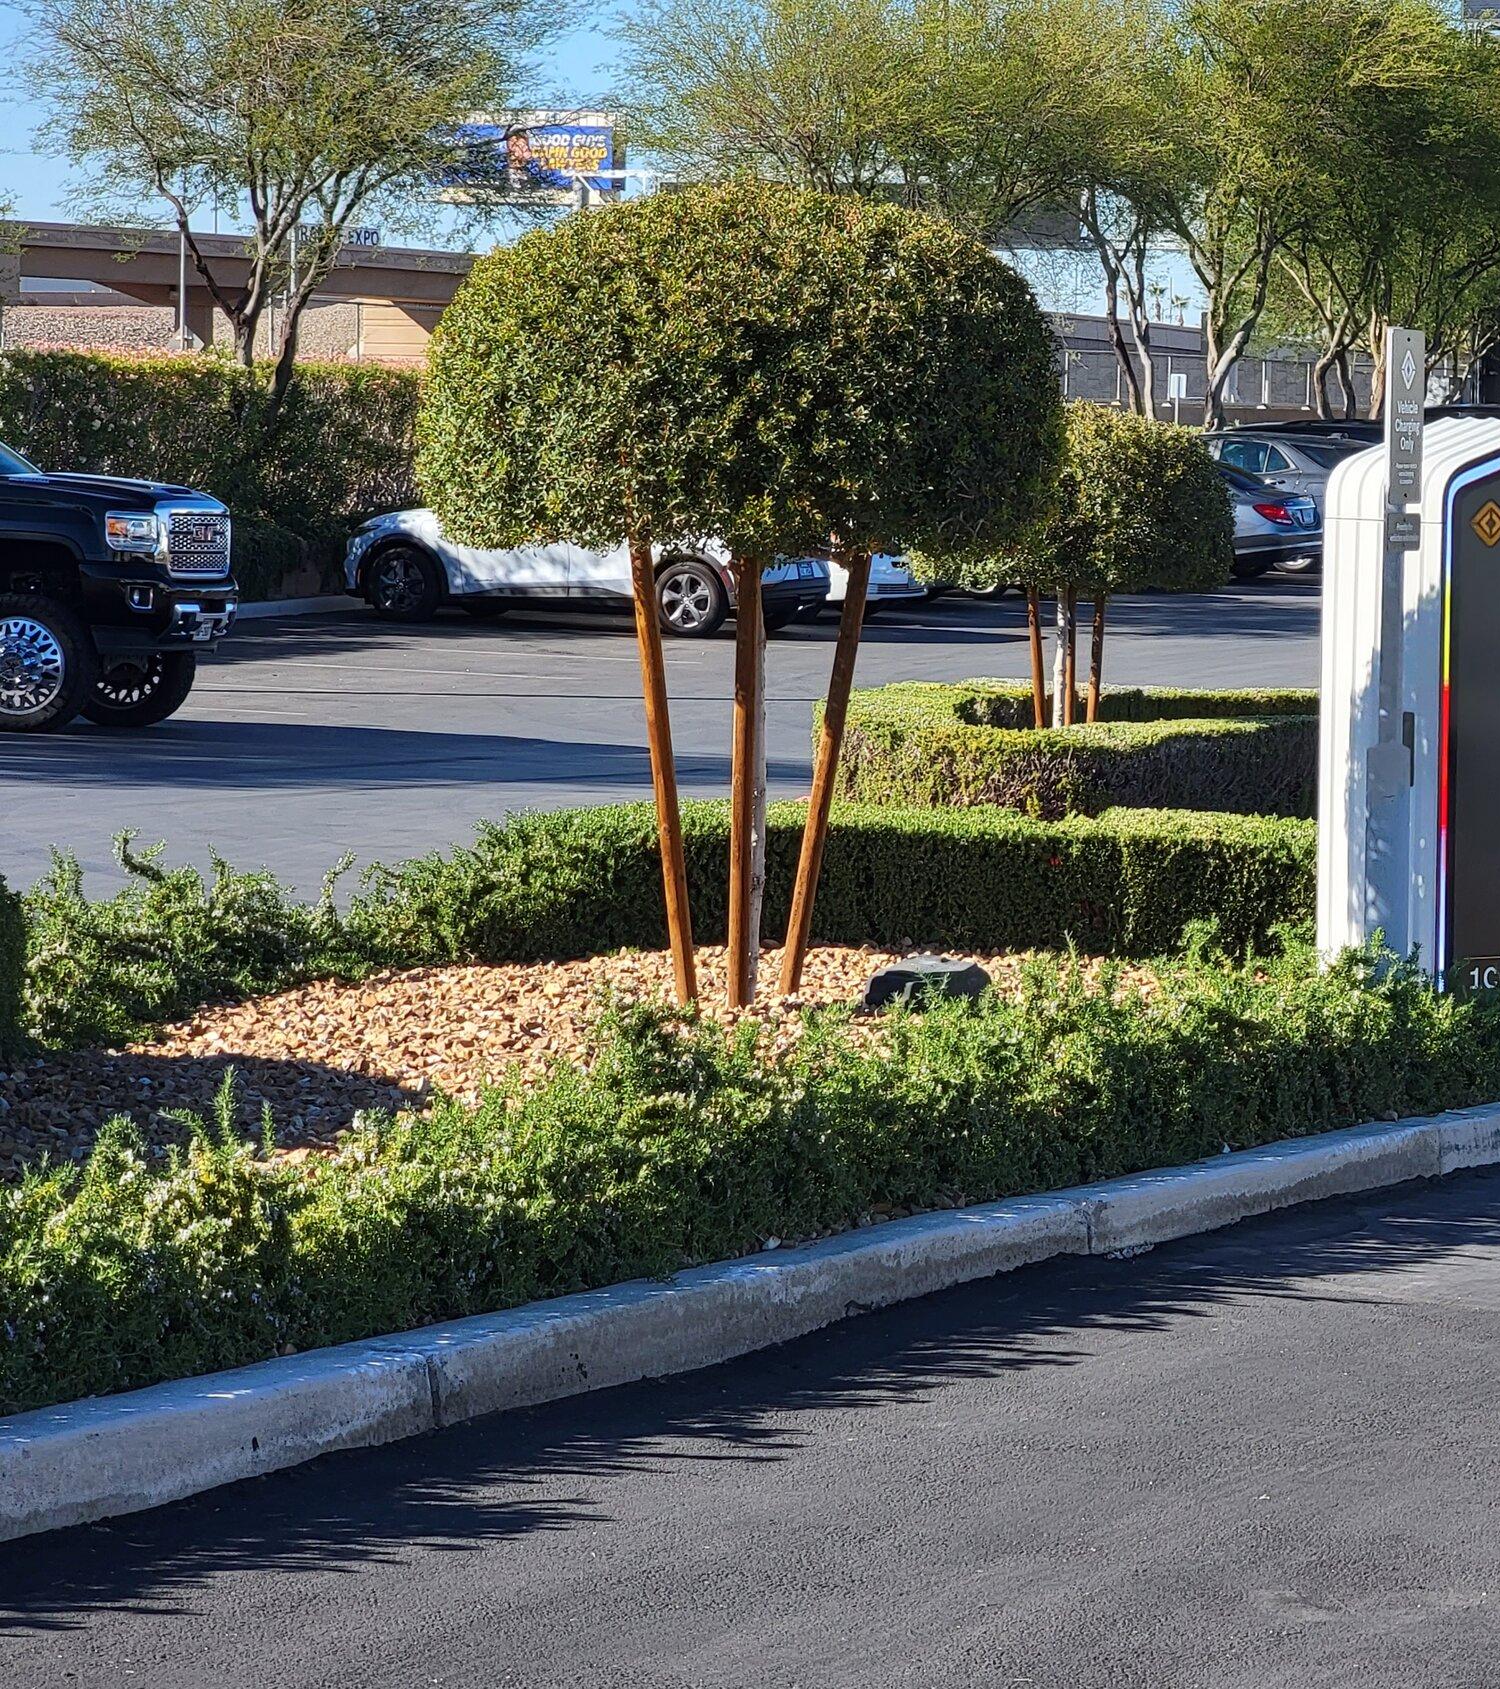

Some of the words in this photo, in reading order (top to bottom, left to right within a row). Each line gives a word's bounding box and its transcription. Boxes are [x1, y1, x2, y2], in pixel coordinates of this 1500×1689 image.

[1397, 401, 1419, 414] Vehicle
[1395, 418, 1420, 436] Charging
[1400, 437, 1415, 453] Only
